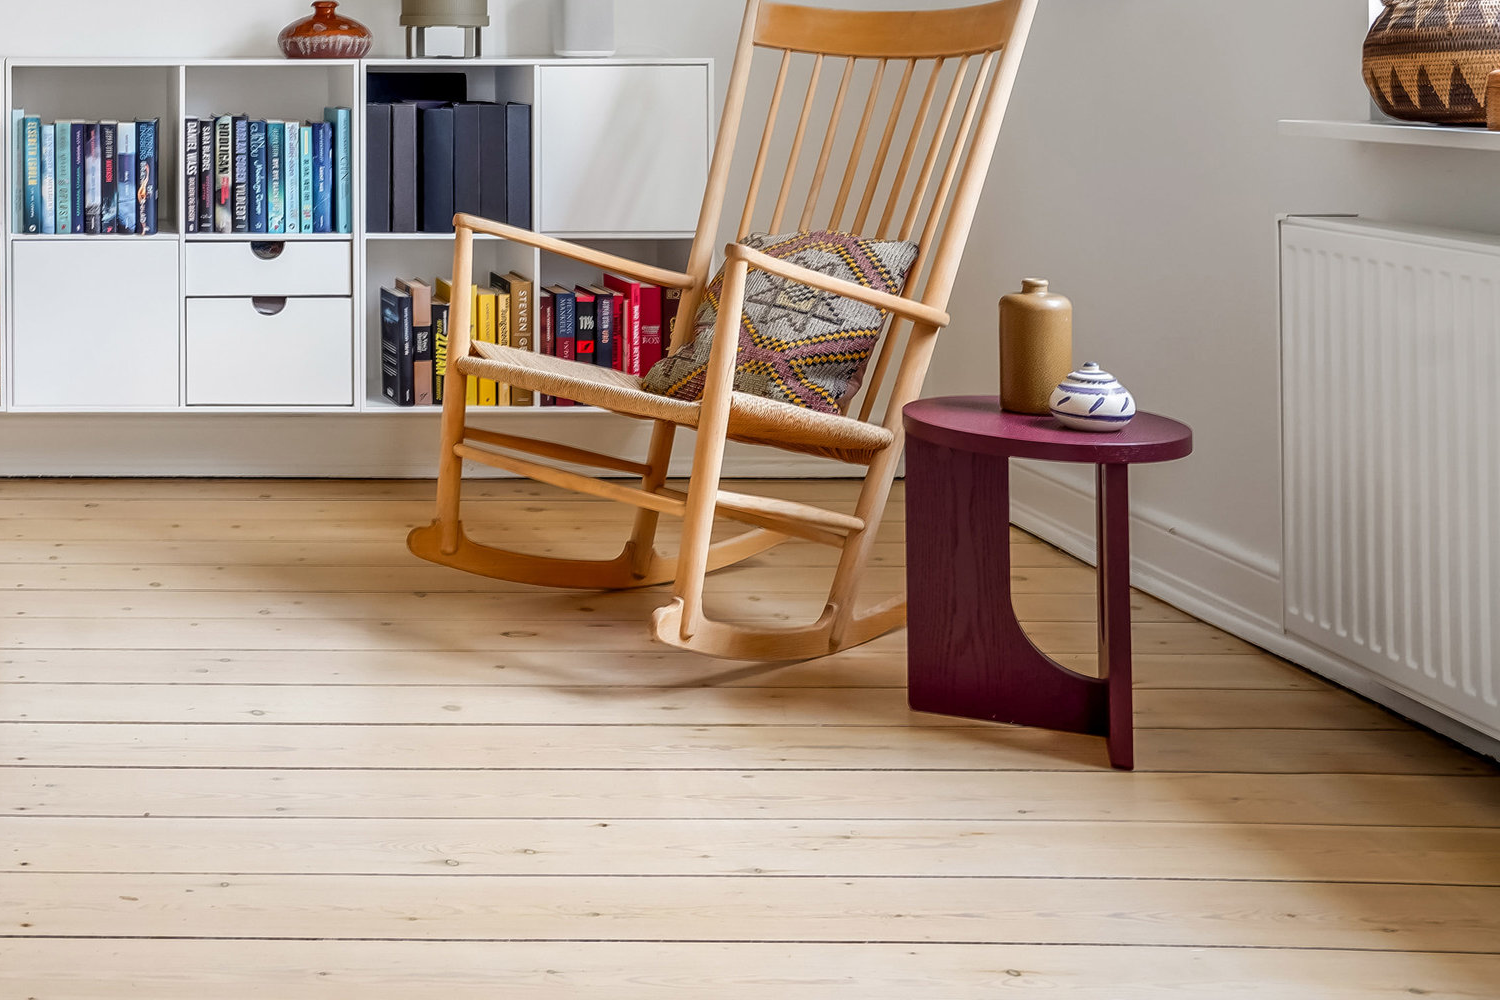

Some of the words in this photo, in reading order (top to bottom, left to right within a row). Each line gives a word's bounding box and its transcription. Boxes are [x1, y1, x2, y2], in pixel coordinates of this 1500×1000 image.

[187, 122, 197, 151] DANIEL
[202, 126, 211, 145] SARA
[219, 123, 229, 174] HOOLIGAN
[236, 120, 246, 154] HARLAN
[187, 152, 197, 175] WASS
[202, 146, 210, 172] BLÆDEL
[236, 155, 246, 183] COBEN
[518, 290, 527, 331] STEVEN
[435, 333, 448, 376] ZLATAN
